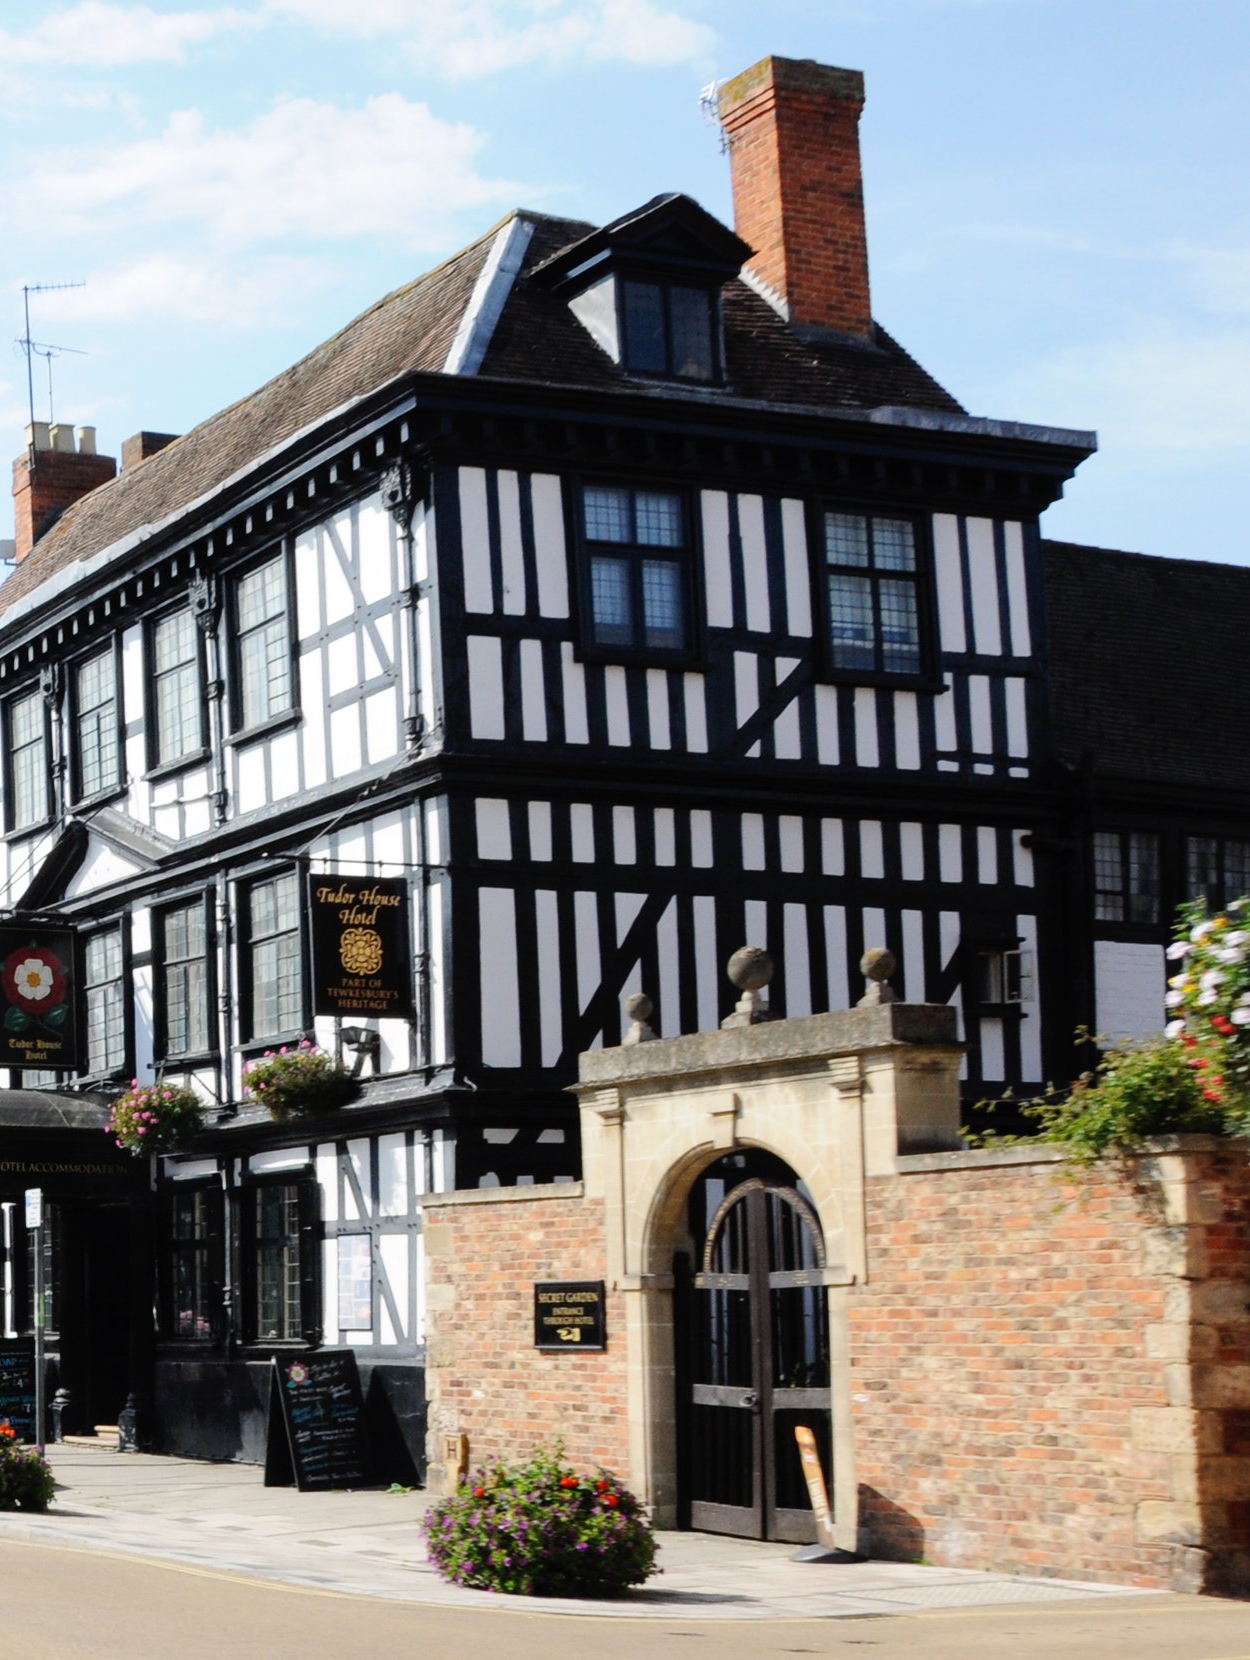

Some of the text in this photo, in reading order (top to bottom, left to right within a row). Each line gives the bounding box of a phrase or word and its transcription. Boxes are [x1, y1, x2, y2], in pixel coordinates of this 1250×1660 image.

[316, 883, 401, 906] Tudor House
[339, 904, 381, 925] Hotel
[341, 979, 383, 989] PART OF
[338, 999, 388, 1010] HERITAGE
[8, 1038, 63, 1050] Tudor House
[29, 1162, 129, 1174] ACCOMMODATION
[538, 1292, 599, 1303] SECRET GARDEN
